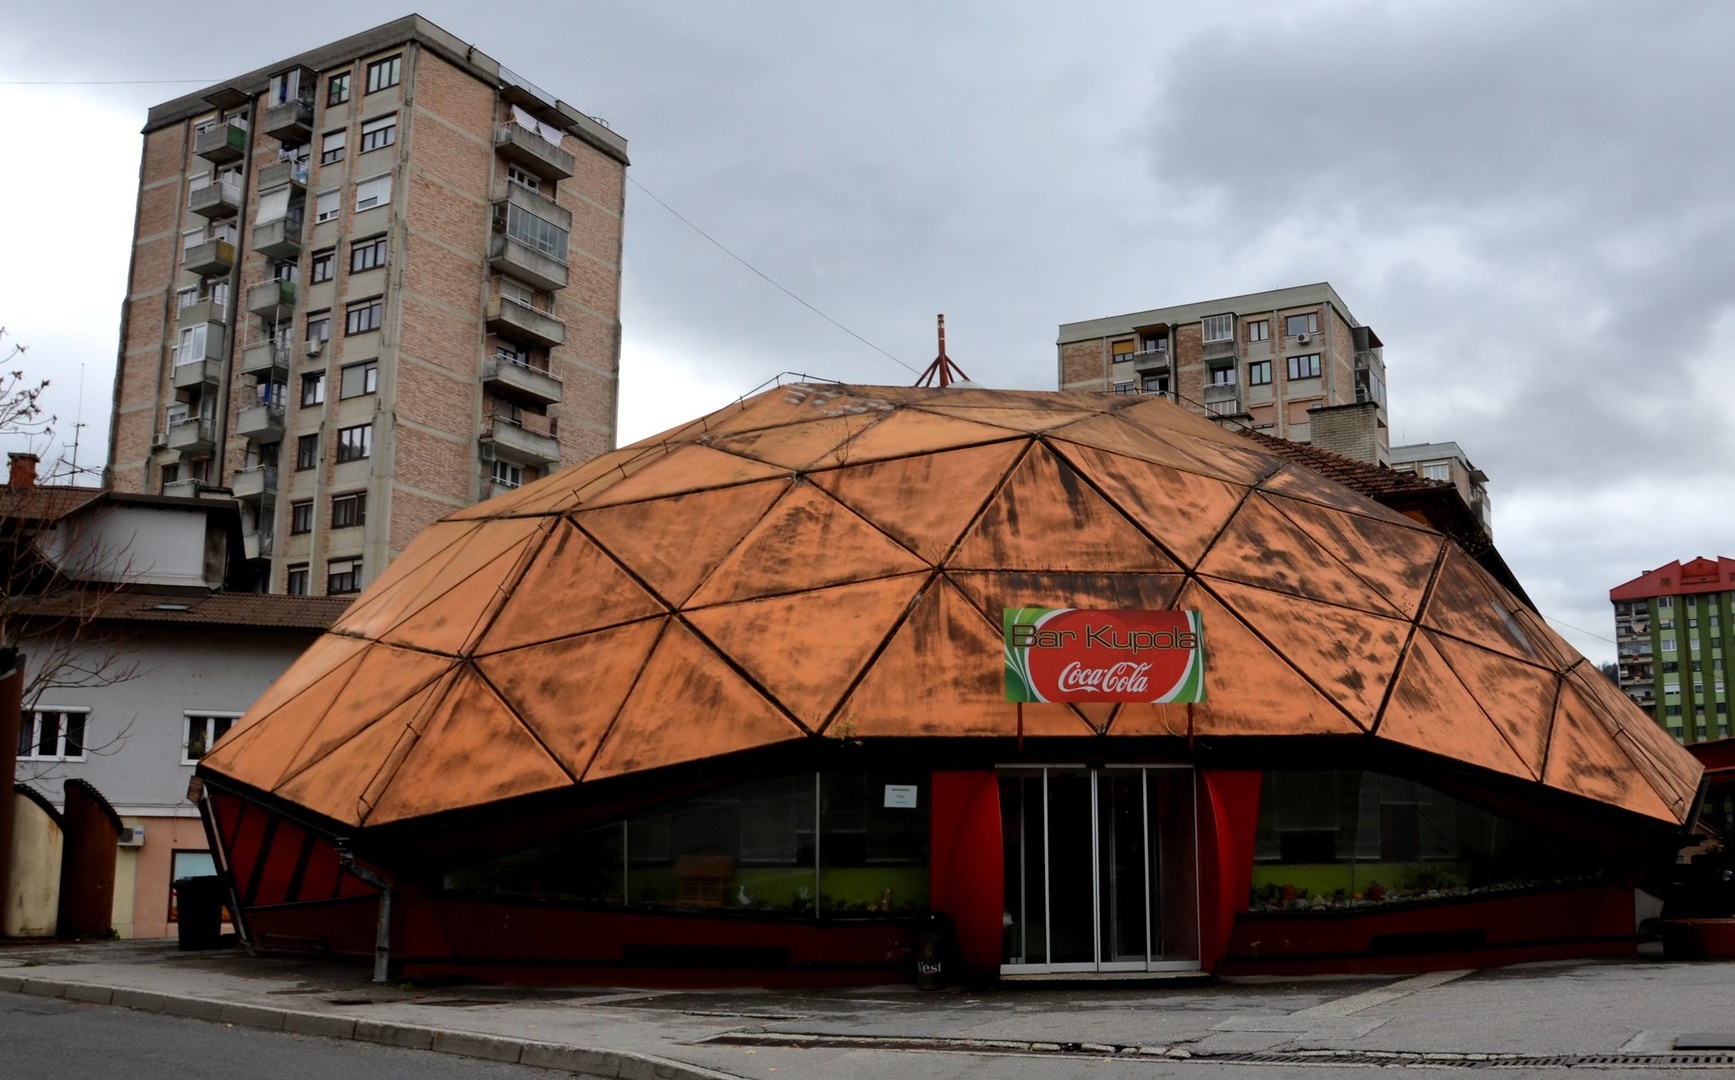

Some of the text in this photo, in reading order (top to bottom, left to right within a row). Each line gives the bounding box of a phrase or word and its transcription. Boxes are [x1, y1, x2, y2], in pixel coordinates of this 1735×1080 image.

[1011, 624, 1198, 654] Bar Kupola
[1058, 661, 1153, 693] Coca-Cola
